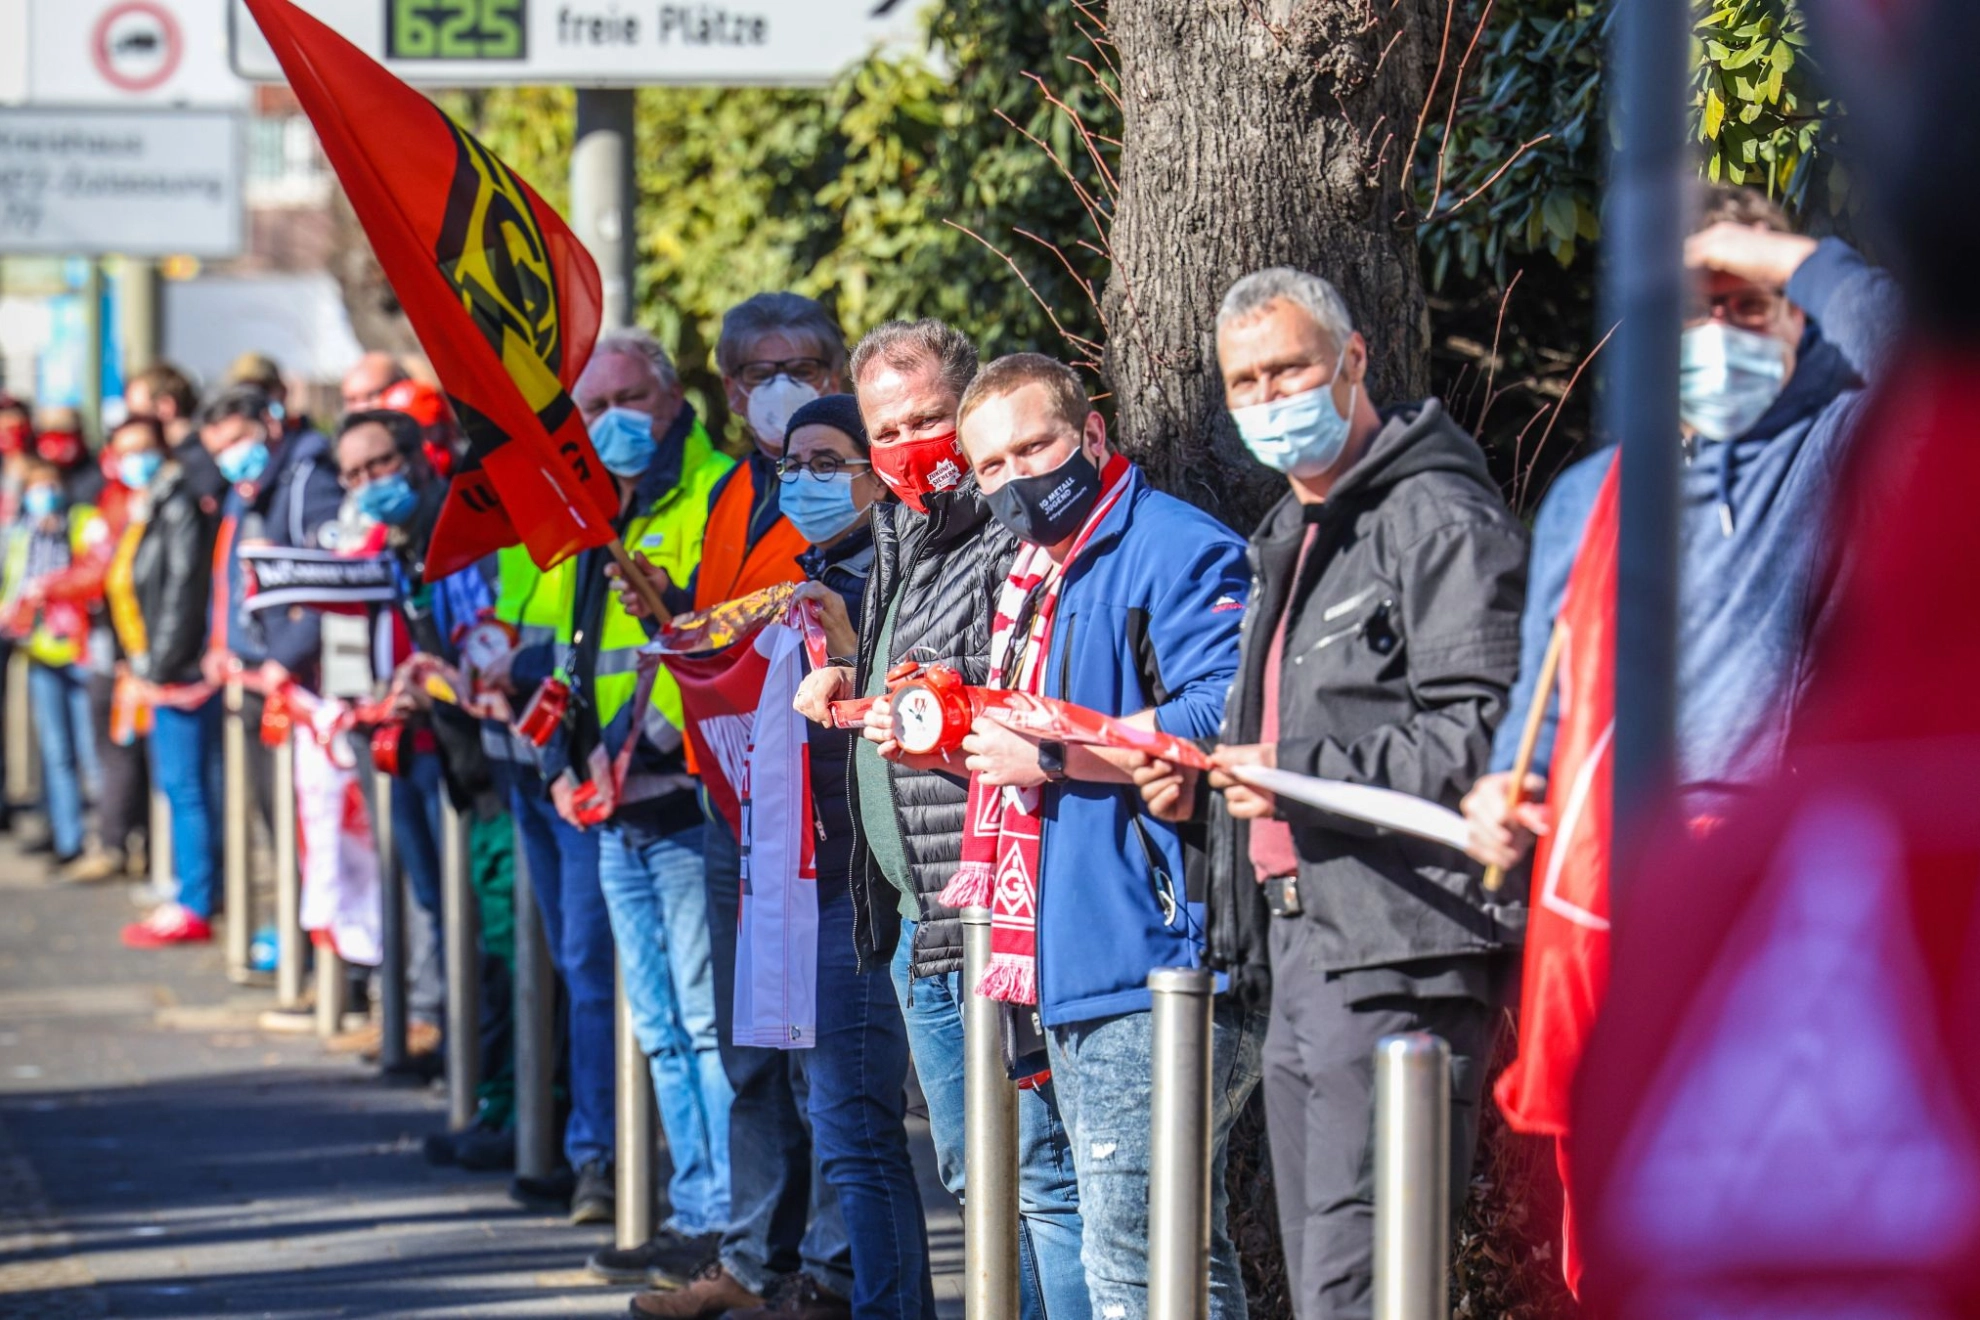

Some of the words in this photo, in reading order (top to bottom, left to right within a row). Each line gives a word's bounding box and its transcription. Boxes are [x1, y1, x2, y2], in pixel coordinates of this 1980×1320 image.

[394, 0, 522, 56] 625
[558, 10, 640, 45] freie
[660, 6, 768, 45] Plätze
[929, 462, 953, 480] ZUKUNFT
[1039, 498, 1049, 509] IG
[1048, 476, 1076, 502] METALL
[1045, 489, 1071, 515] JUGEND
